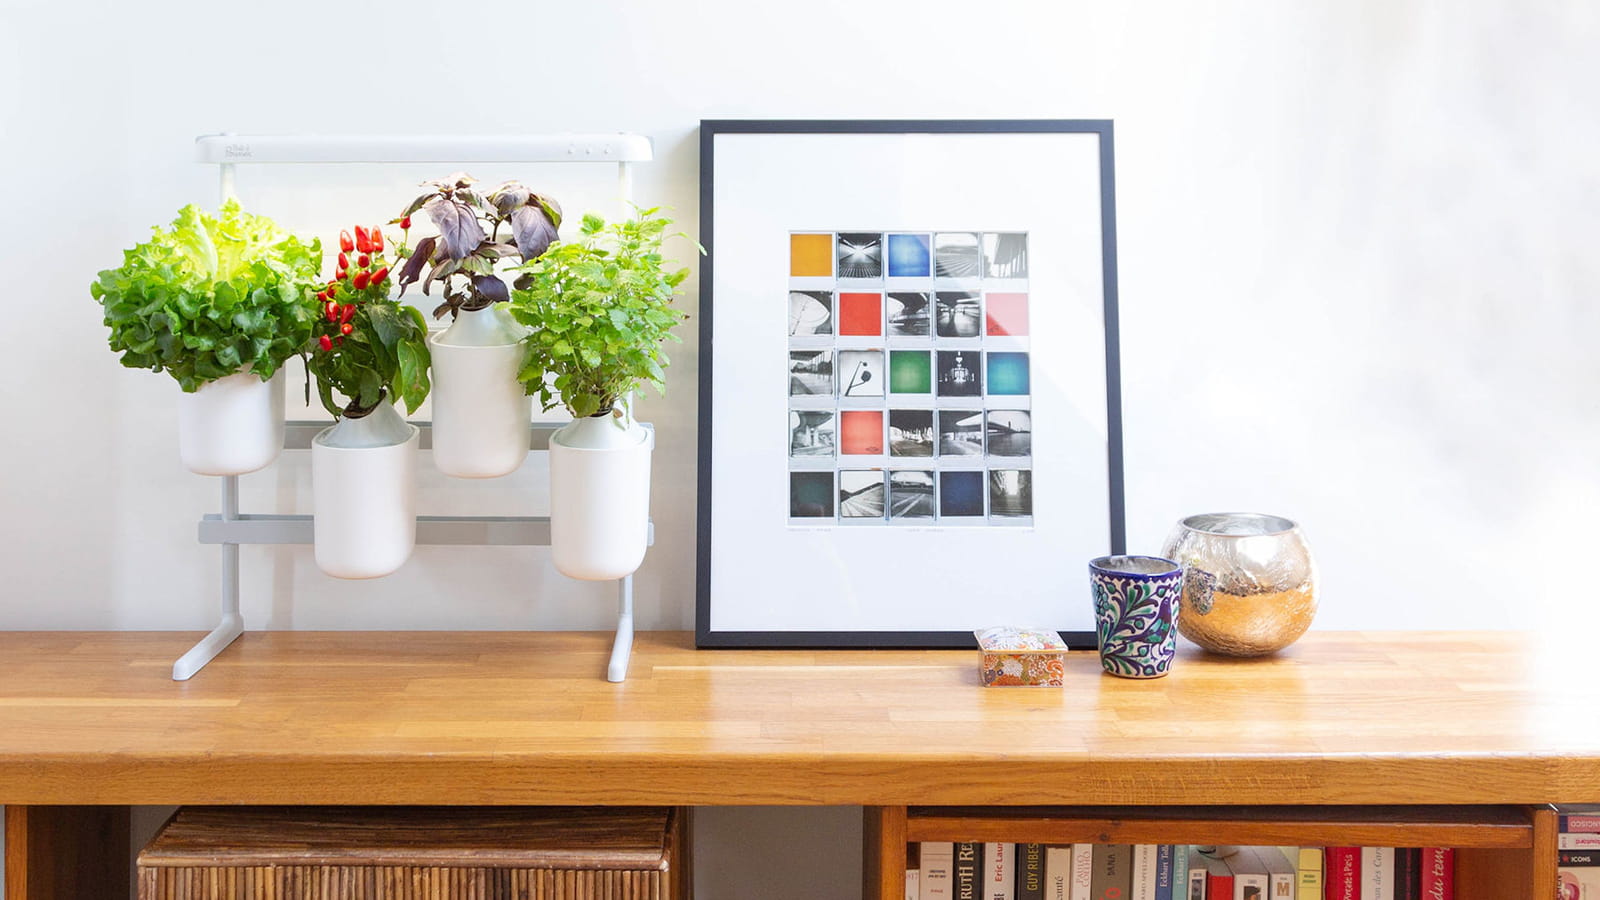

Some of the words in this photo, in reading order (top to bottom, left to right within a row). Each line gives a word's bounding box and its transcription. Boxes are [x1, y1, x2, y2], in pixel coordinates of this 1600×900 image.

[1028, 843, 1039, 870] RIBES
[1107, 854, 1115, 876] DANA
[1344, 853, 1353, 871] Paris
[994, 864, 1003, 882] Eric
[1075, 855, 1083, 883] PAULO
[1082, 851, 1090, 887] COELHO
[1159, 862, 1169, 887] Eckhart
[1372, 871, 1382, 885] des
[959, 866, 974, 900] RUTH
[1026, 873, 1038, 891] GUY
[1277, 882, 1289, 896] M
[1428, 879, 1444, 900] du
